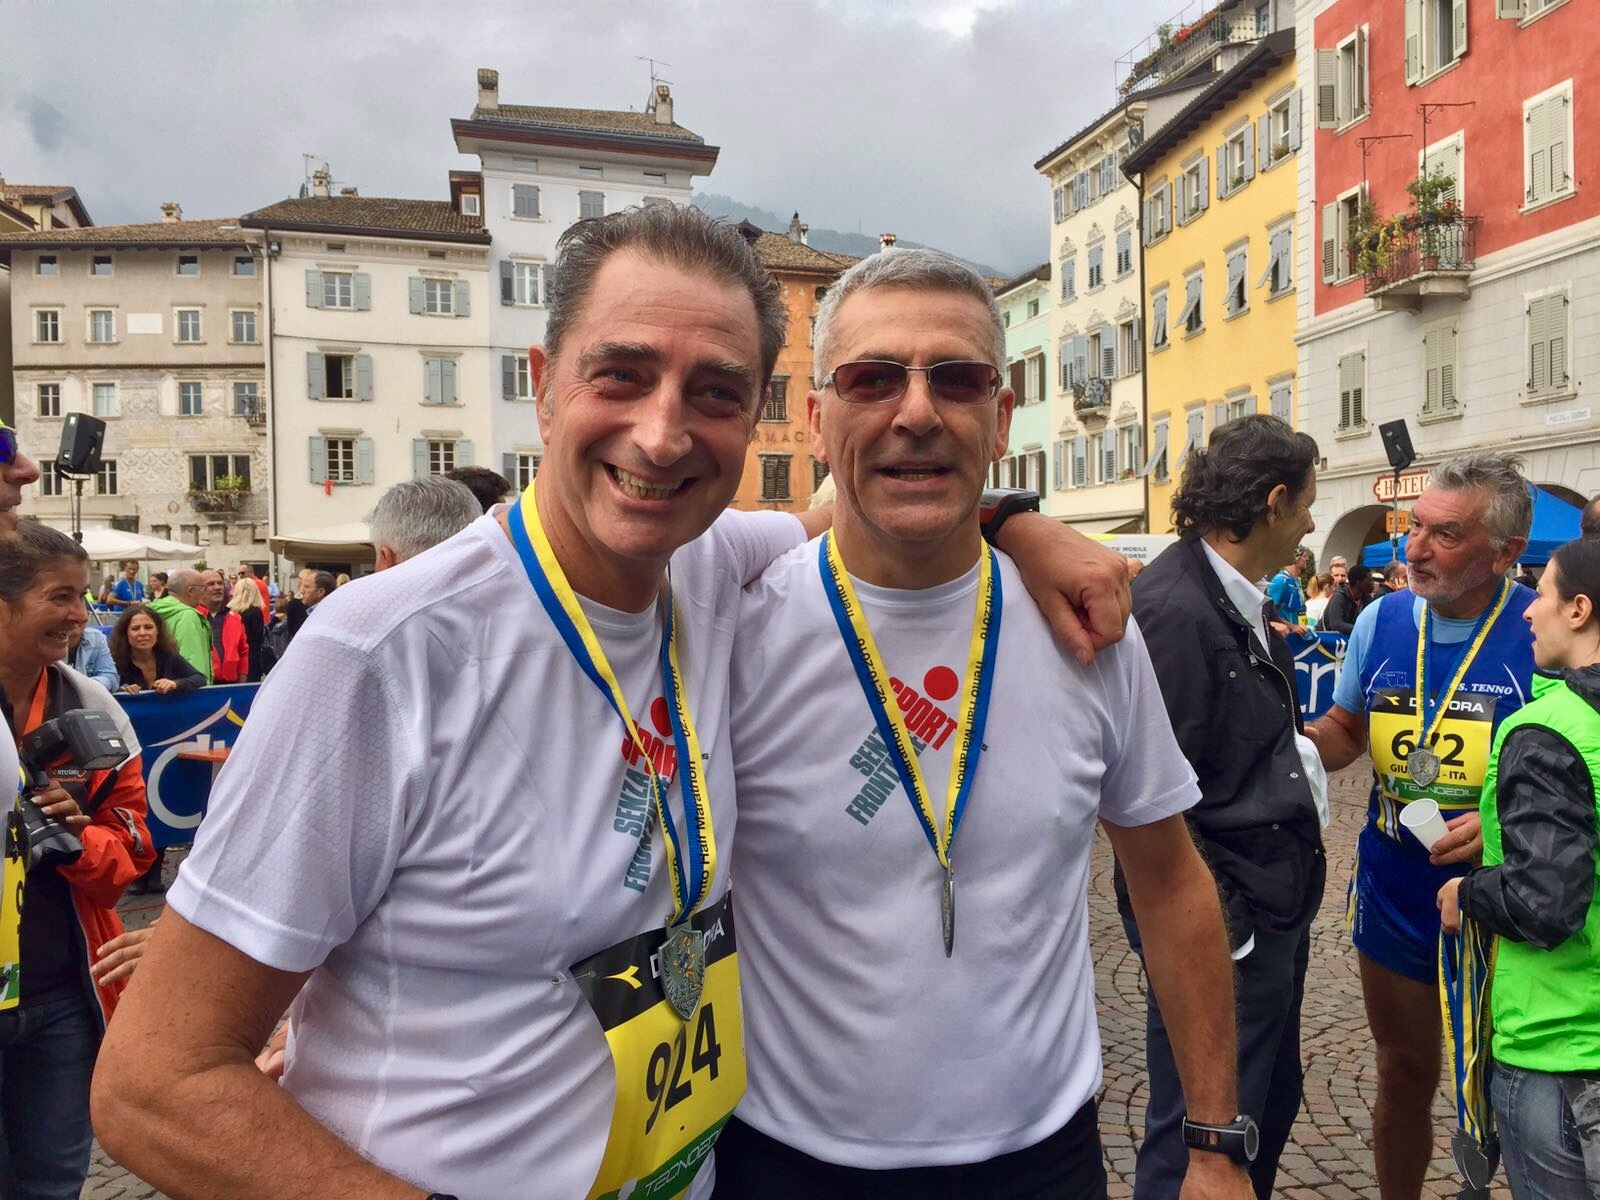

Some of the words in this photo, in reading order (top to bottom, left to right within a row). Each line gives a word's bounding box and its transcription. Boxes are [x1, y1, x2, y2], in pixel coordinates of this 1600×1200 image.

[1388, 516, 1406, 526] TXI
[1471, 683, 1514, 696] TENNO
[688, 760, 706, 833] Marathon
[1449, 770, 1467, 781] ITA
[613, 768, 650, 839] SENZA
[645, 1002, 722, 1136] 924
